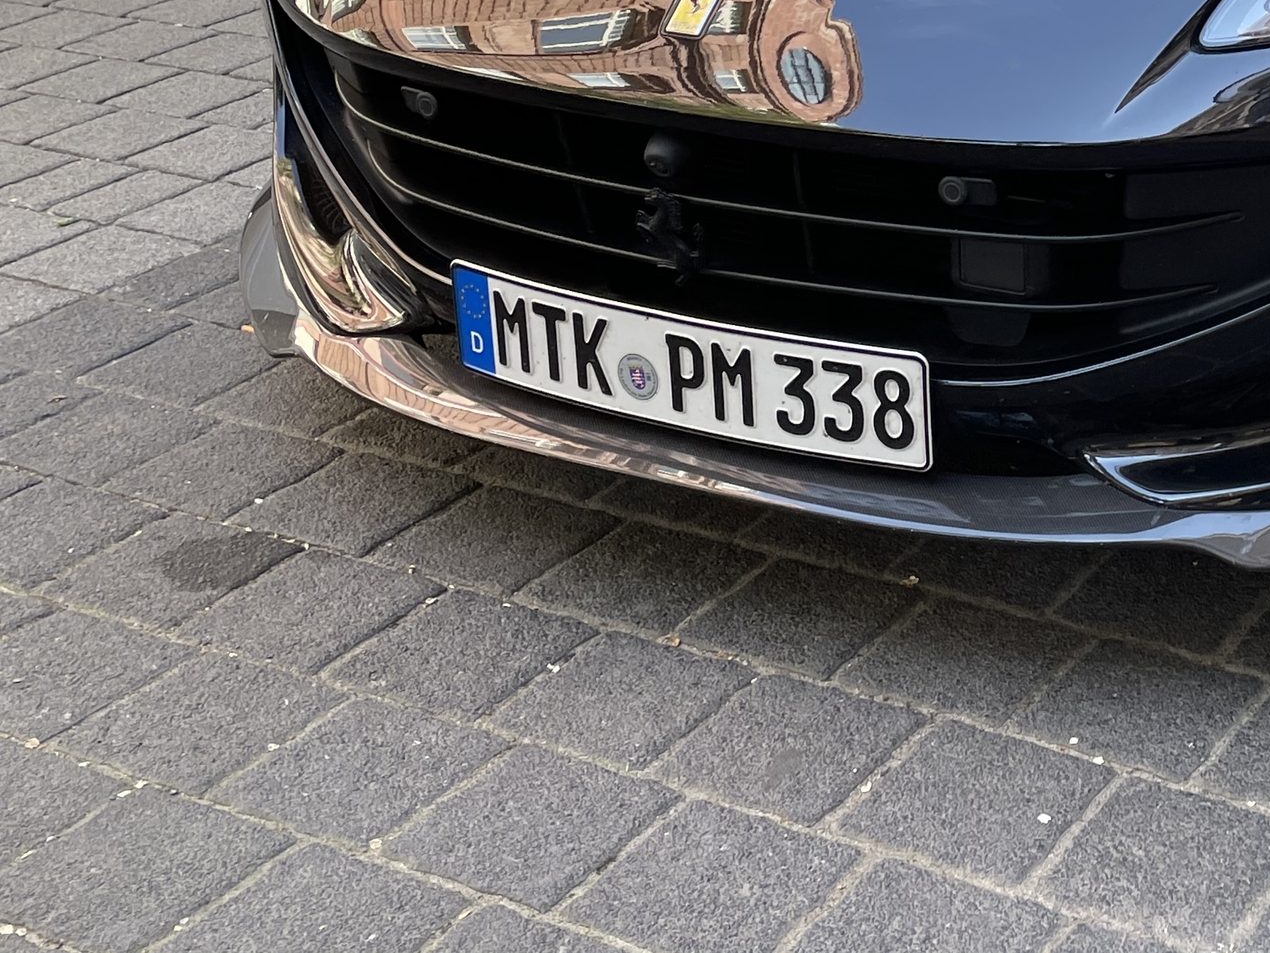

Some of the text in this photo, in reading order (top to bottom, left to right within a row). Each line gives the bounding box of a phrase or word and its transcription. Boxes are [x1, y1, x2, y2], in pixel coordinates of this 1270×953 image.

[493, 290, 614, 396] MTK
[665, 333, 756, 427] PM
[774, 353, 915, 450] 338
